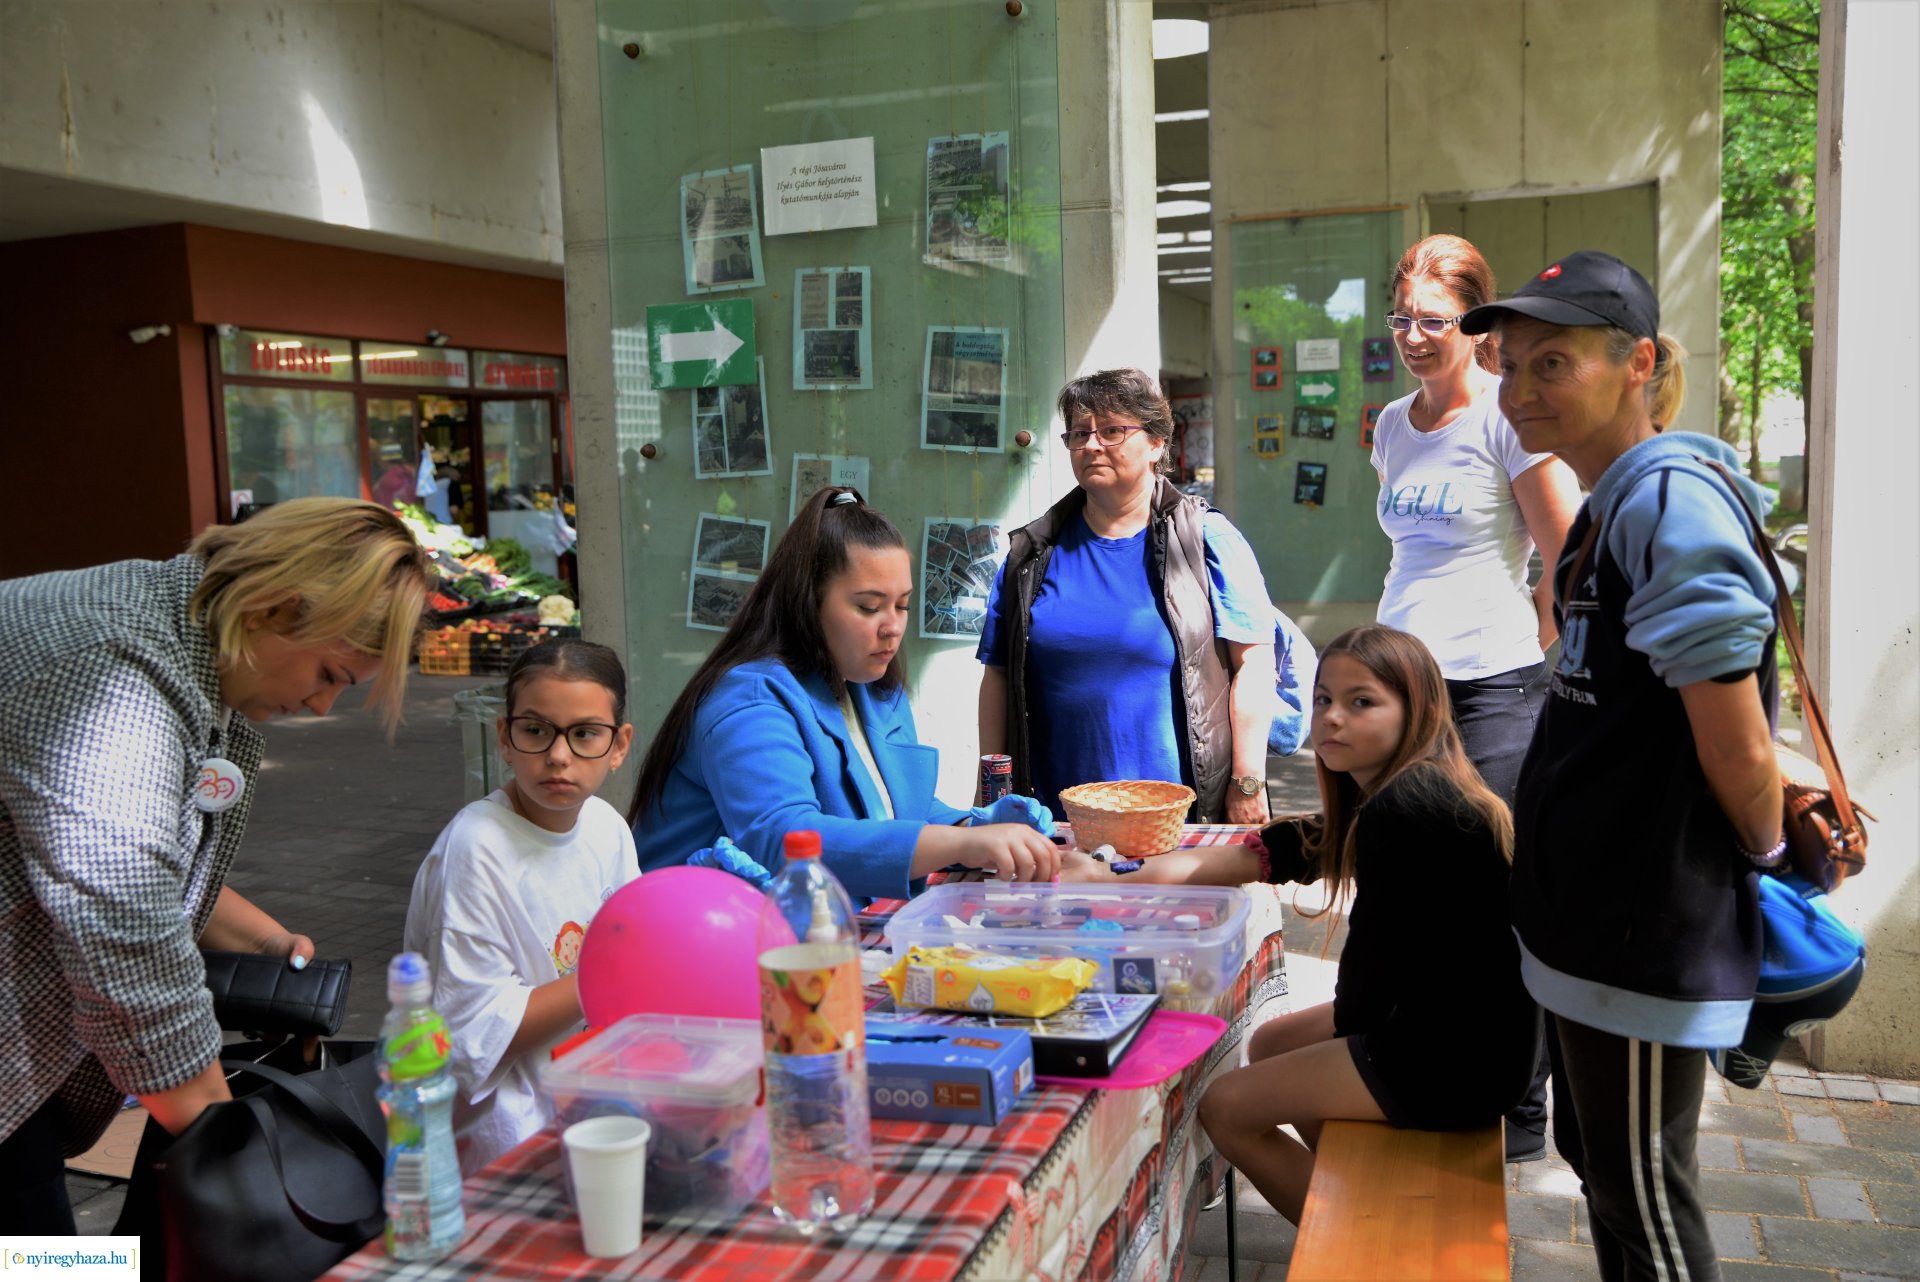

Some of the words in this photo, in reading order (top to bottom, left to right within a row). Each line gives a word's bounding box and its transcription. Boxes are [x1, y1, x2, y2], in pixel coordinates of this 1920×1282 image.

[790, 167, 797, 176] A
[799, 165, 812, 176] régi
[813, 162, 847, 174] Jósaváros
[795, 178, 817, 191] Gábor
[780, 191, 833, 205] kutatómunkája
[834, 189, 860, 201] alapján
[840, 470, 858, 479] EGY
